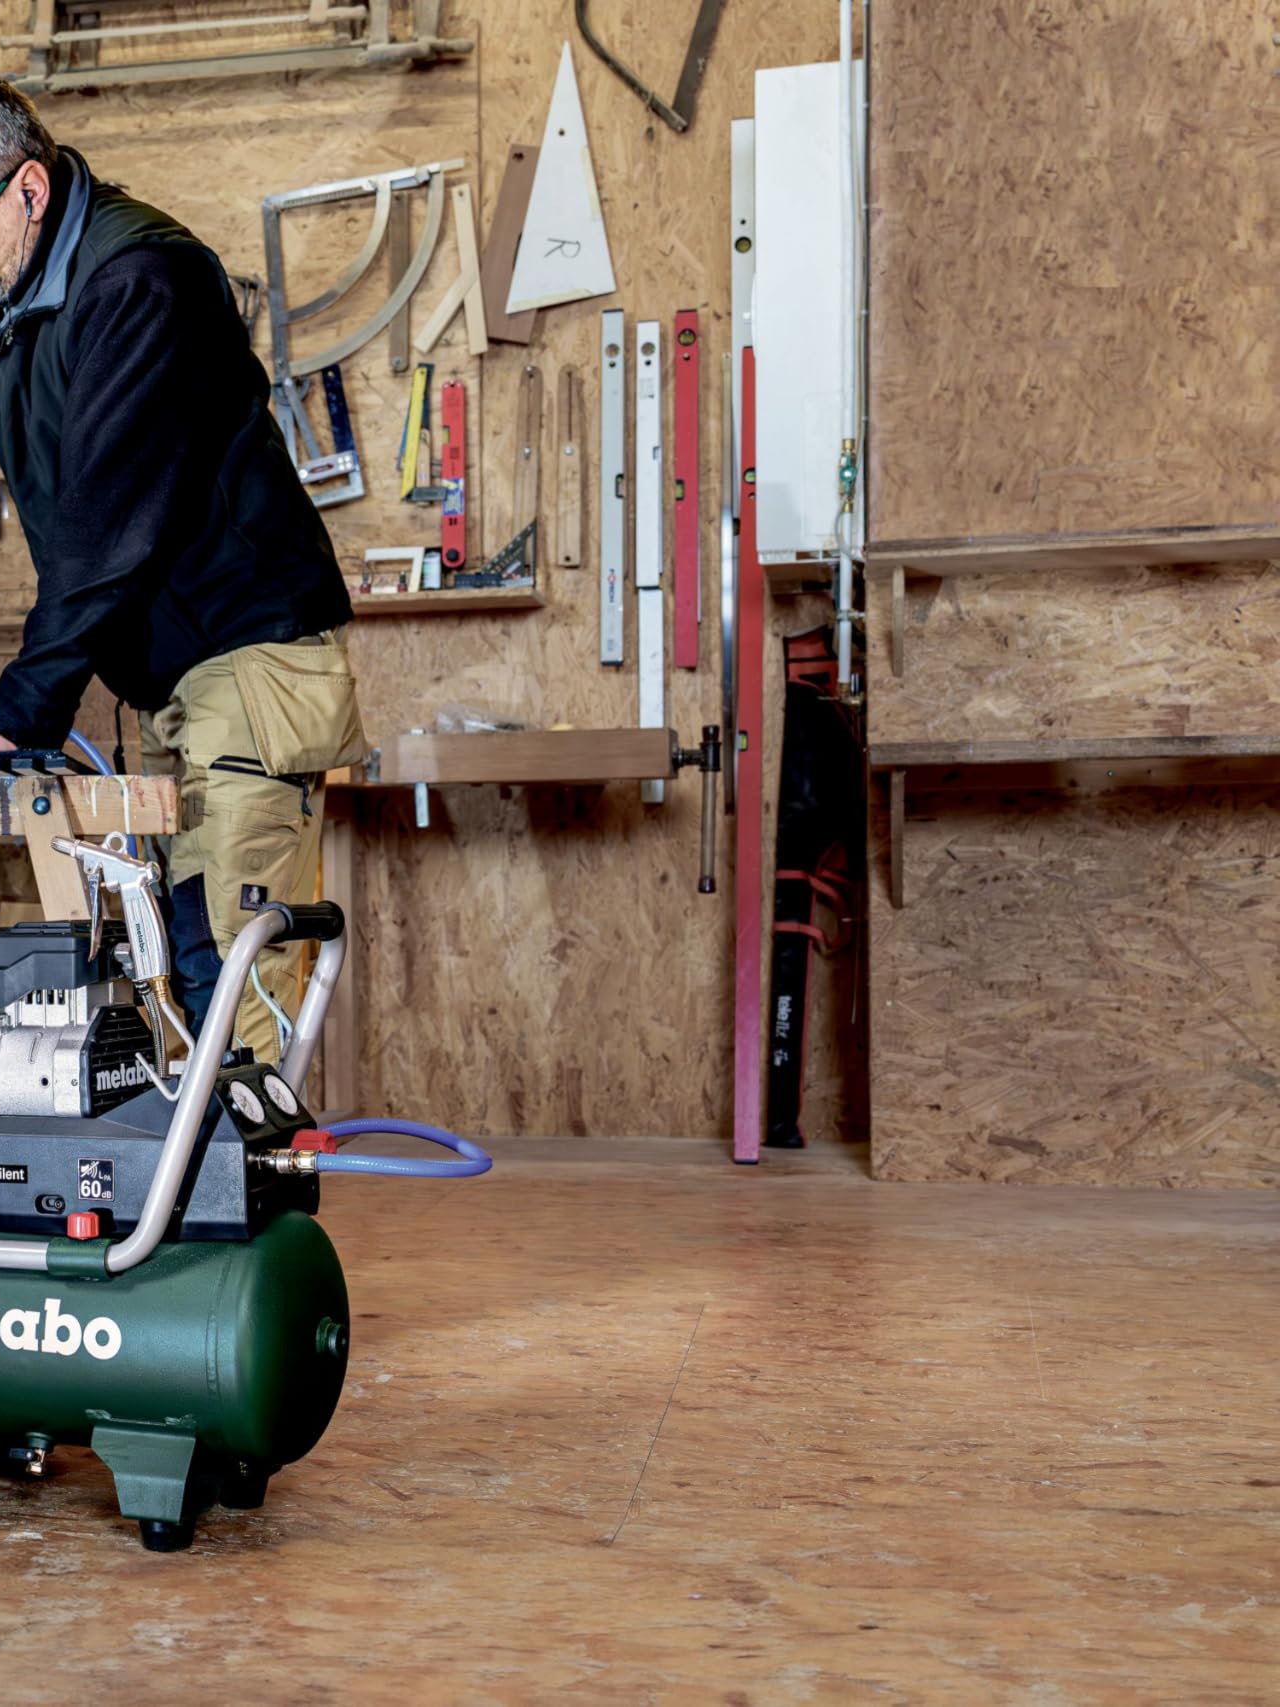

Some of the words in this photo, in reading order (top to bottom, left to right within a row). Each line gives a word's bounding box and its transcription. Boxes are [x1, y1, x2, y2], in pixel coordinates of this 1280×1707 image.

[544, 238, 581, 258] R
[135, 923, 145, 953] metabo
[80, 1180, 101, 1198] 60
